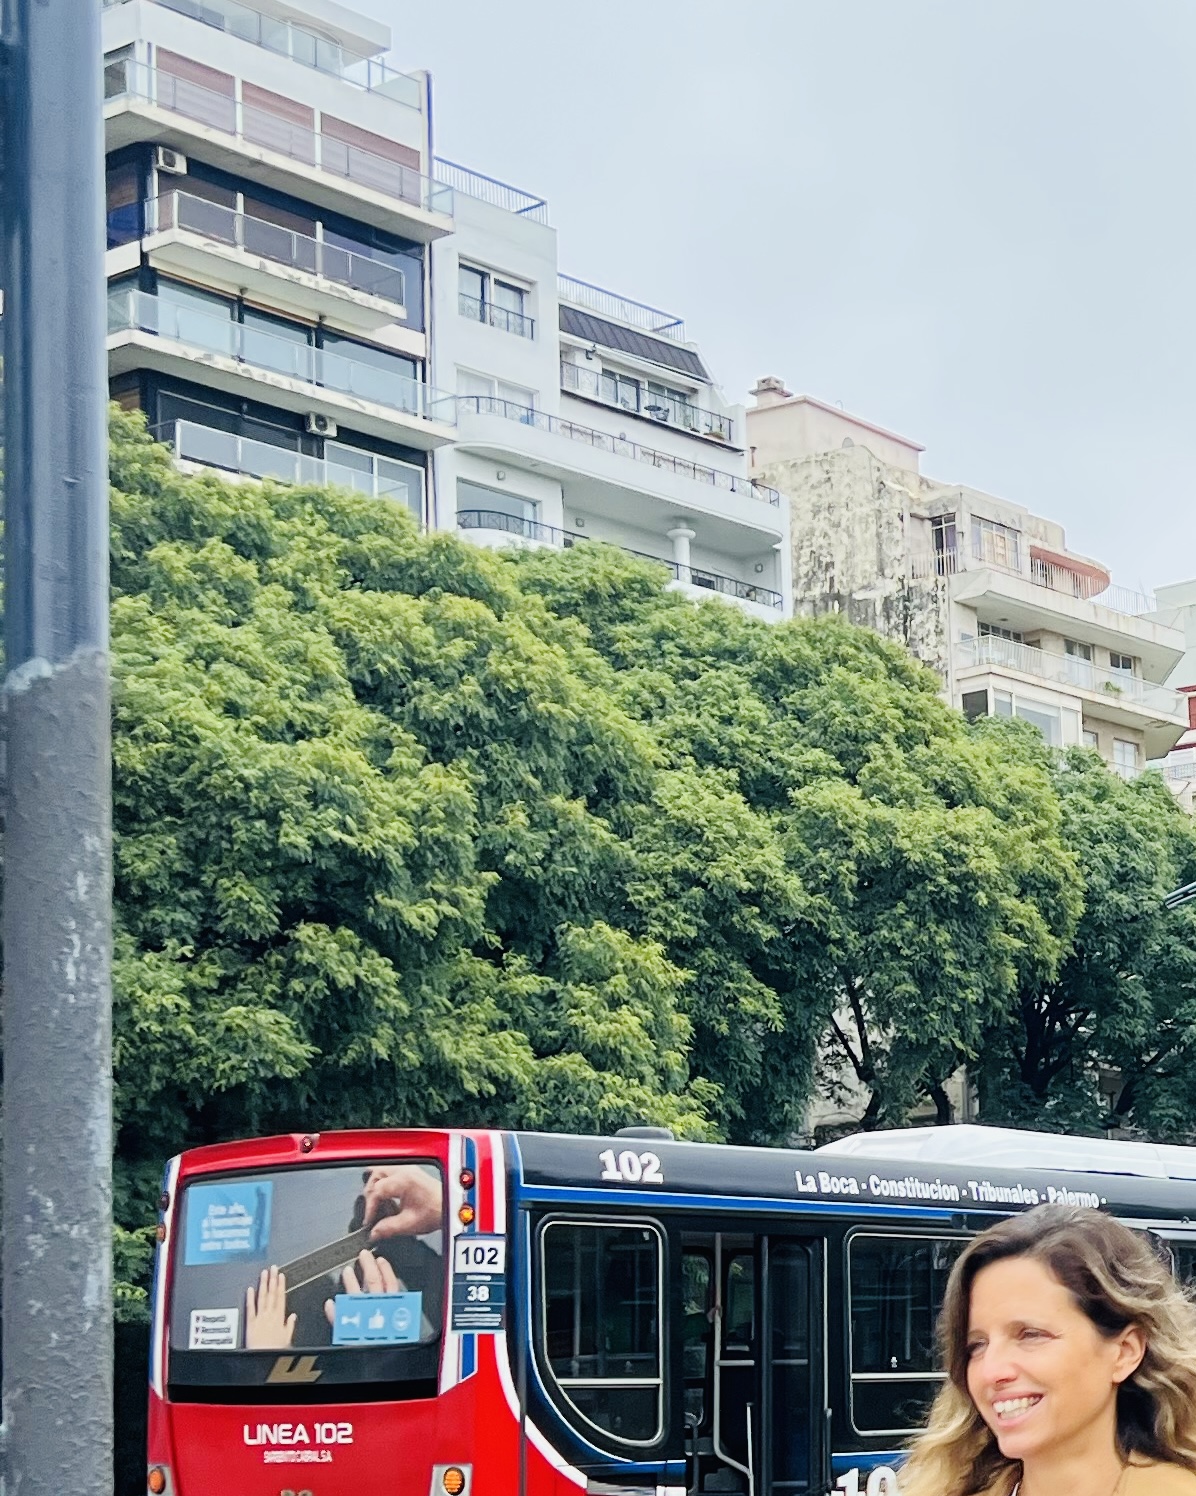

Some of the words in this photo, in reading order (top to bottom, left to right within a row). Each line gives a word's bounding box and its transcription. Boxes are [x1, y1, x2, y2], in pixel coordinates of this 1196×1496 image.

[599, 1149, 664, 1184] 102
[795, 1171, 818, 1193] La
[818, 1171, 860, 1195] Boca
[869, 1174, 960, 1201] Constitucion
[968, 1181, 1040, 1205] Tribunales
[1046, 1186, 1099, 1209] Palermo
[461, 1246, 499, 1265] 102
[467, 1285, 490, 1302] 38
[243, 1423, 311, 1445] LINEA
[313, 1421, 354, 1444] 102
